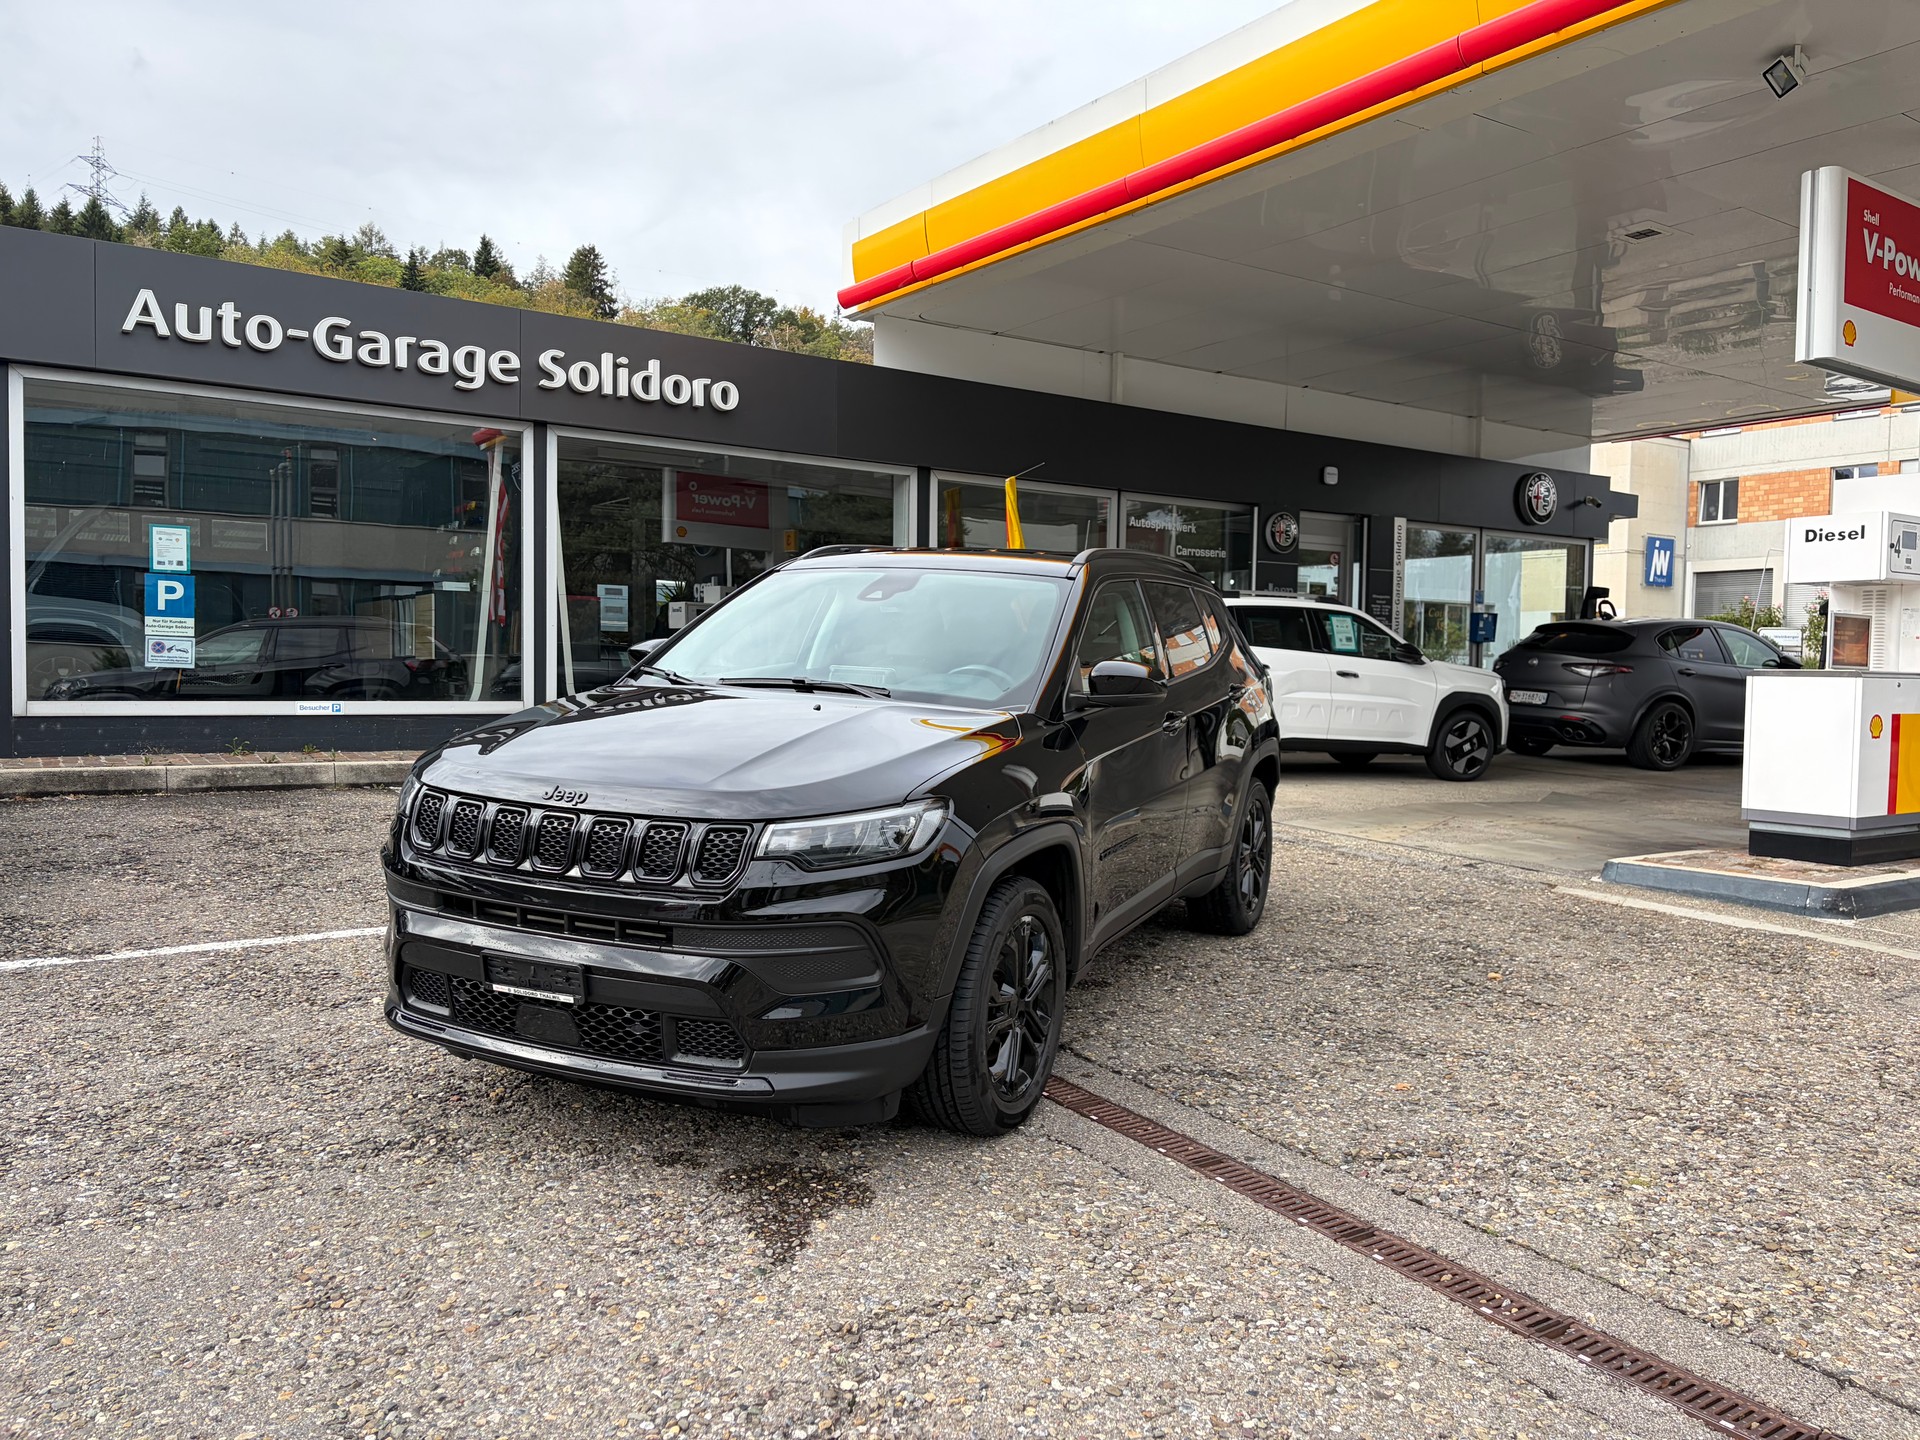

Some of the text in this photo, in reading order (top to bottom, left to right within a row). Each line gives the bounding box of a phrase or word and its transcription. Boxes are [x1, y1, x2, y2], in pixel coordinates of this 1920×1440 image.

[1863, 209, 1880, 226] Shell
[121, 288, 740, 412] Auto-Garage Solidoro
[1129, 516, 1197, 533] Autospritzwerk
[1804, 524, 1866, 543] Diesel
[1176, 545, 1227, 558] Carrosserie
[1894, 535, 1902, 559] 4
[157, 580, 185, 610] P
[1394, 569, 1403, 633] Auto-Garage
[541, 785, 588, 806] Jeep
